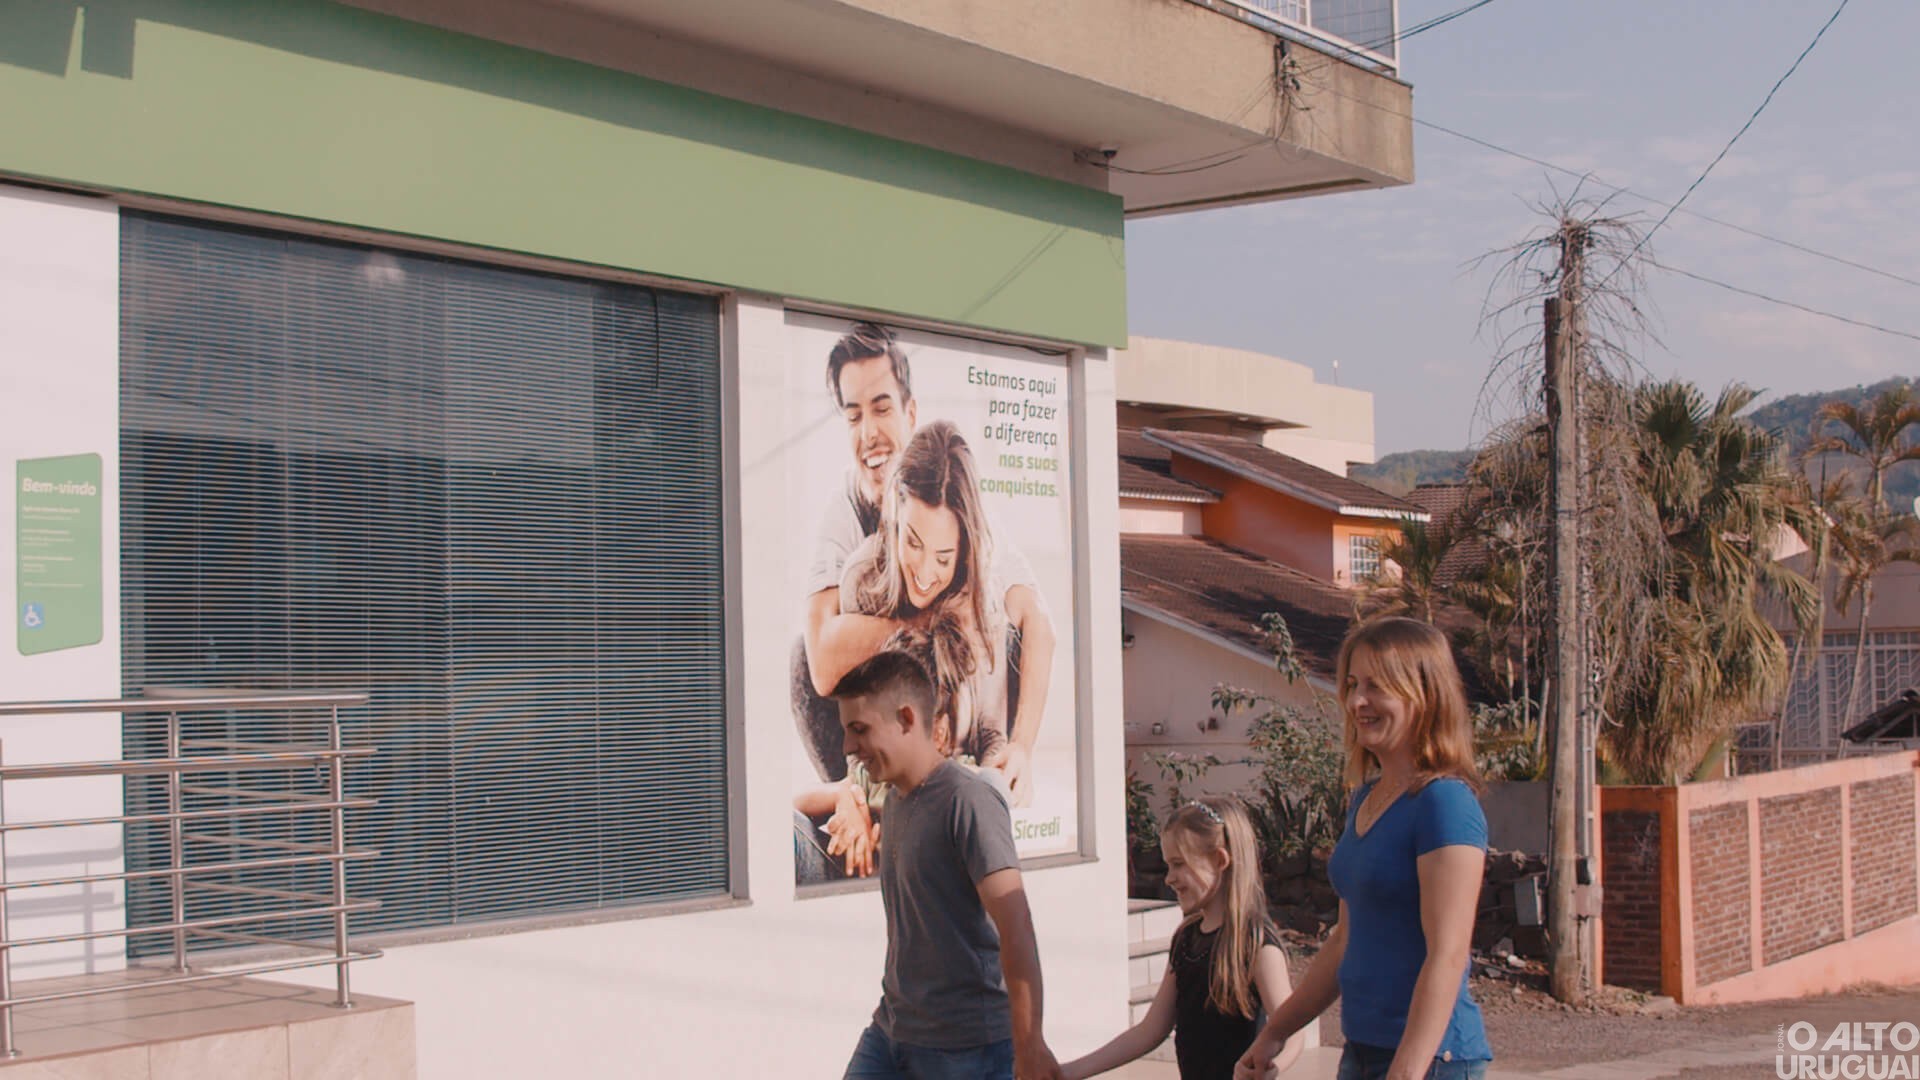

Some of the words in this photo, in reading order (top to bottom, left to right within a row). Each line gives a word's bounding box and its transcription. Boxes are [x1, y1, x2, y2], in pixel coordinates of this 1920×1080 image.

[967, 365, 1026, 391] Estamos
[1028, 378, 1057, 398] aqui
[989, 399, 1020, 417] para
[1021, 399, 1057, 421] fazer
[984, 425, 992, 439] a
[995, 423, 1057, 451] diferença
[998, 453, 1024, 469] nas
[1026, 456, 1059, 472] suas
[22, 477, 97, 497] Bem-vindo
[979, 478, 1059, 499] conquistas.
[1013, 815, 1061, 841] Sicredi
